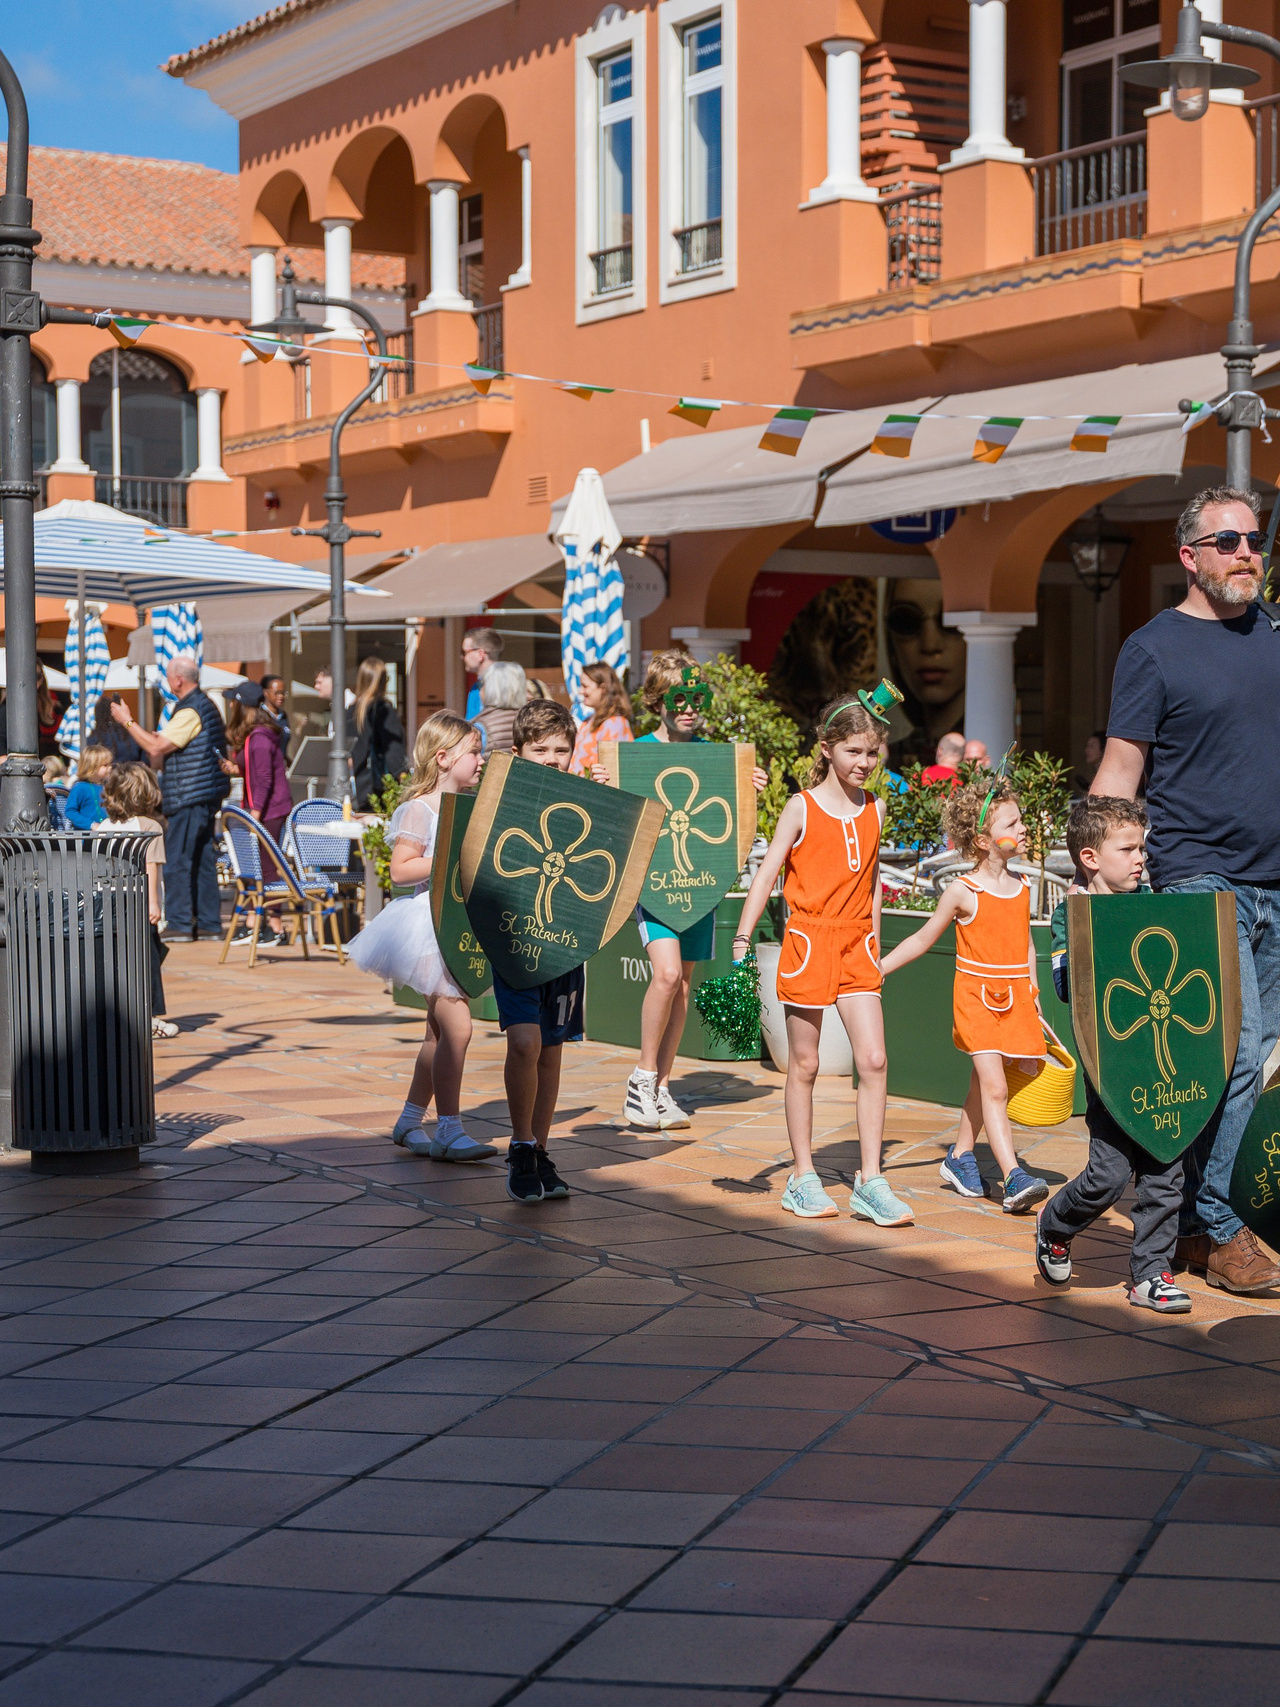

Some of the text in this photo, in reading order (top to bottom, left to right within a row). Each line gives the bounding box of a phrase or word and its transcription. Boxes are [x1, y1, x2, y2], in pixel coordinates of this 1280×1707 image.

[649, 871, 672, 891] St.
[498, 910, 522, 935] St.
[1131, 1086, 1155, 1114] St.
